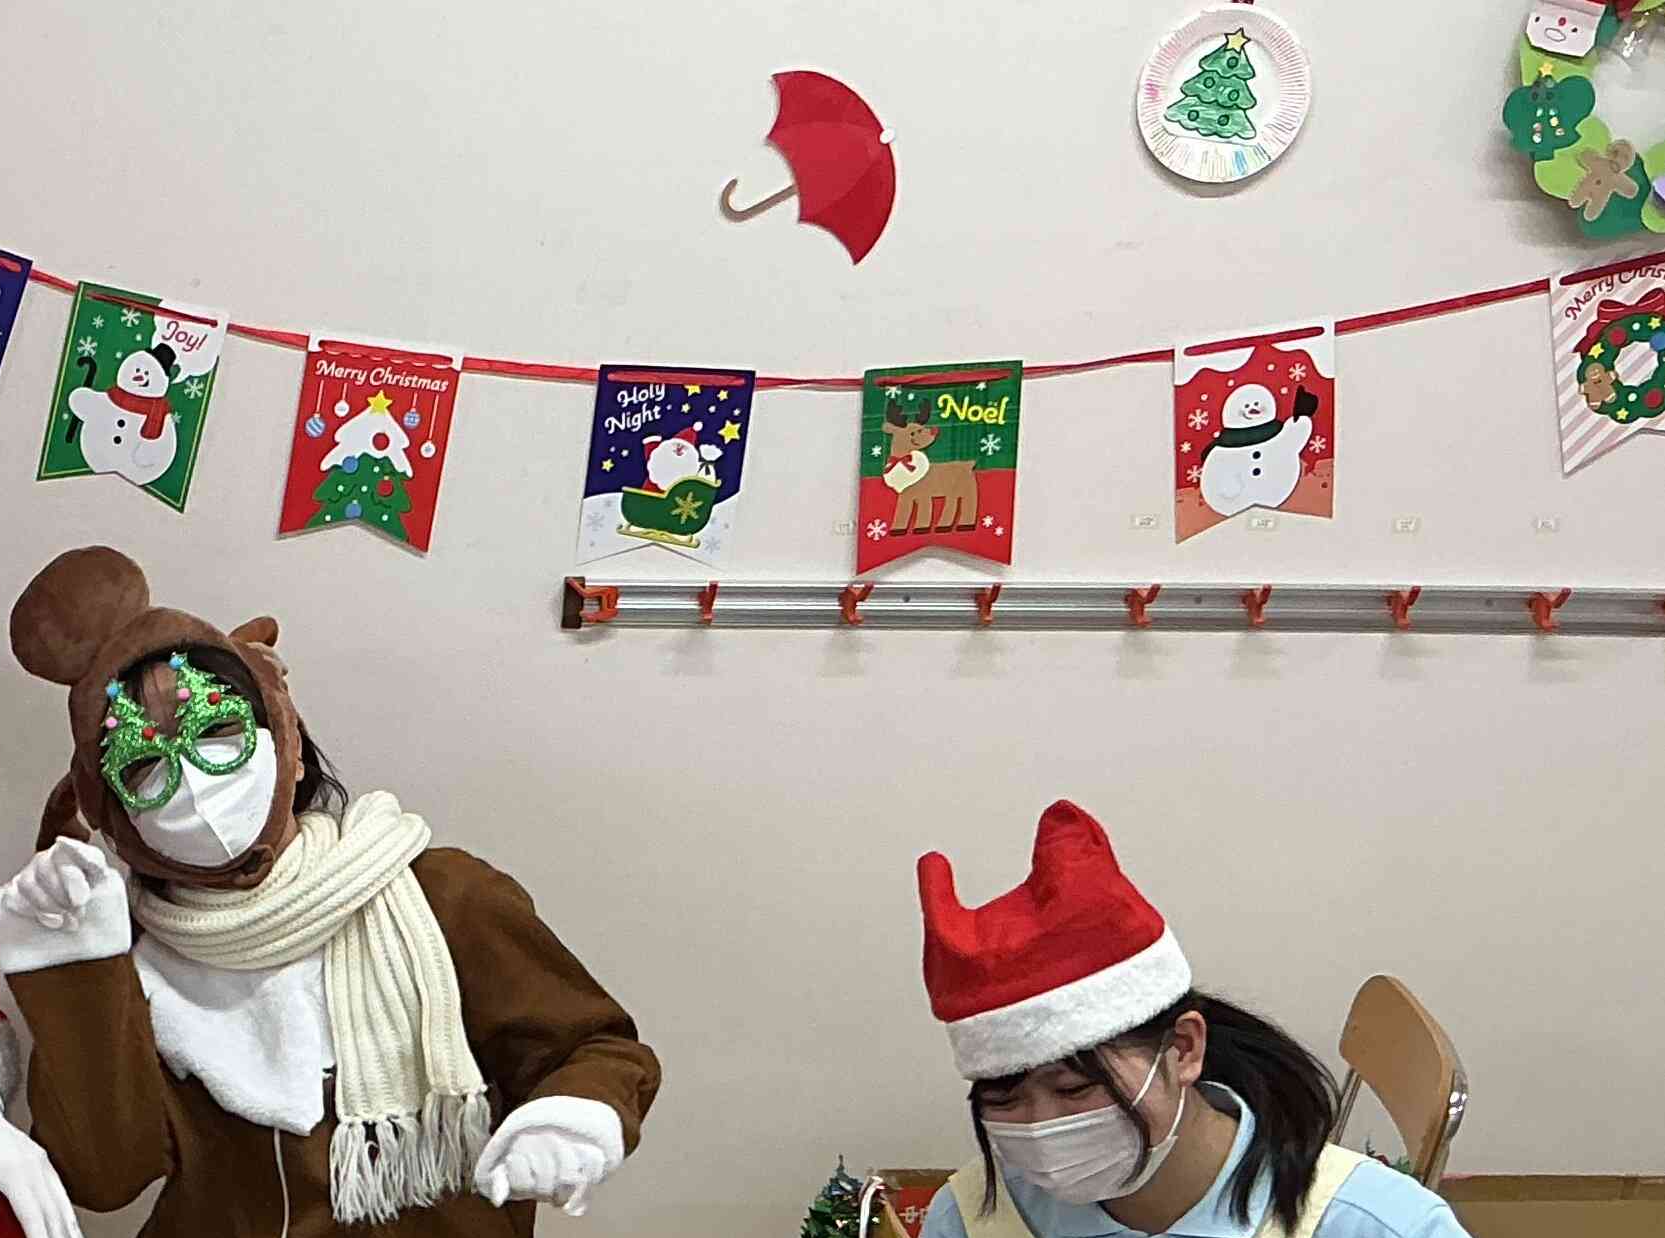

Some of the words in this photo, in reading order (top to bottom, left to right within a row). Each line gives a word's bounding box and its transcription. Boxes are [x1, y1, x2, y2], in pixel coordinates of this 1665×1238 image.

[1564, 273, 1615, 321] Merry
[161, 320, 209, 352] Joy!
[316, 360, 368, 386] Merry
[369, 366, 449, 392] Christmas
[617, 383, 665, 408] Holy
[937, 393, 1009, 424] Noël
[604, 403, 662, 434] Night
